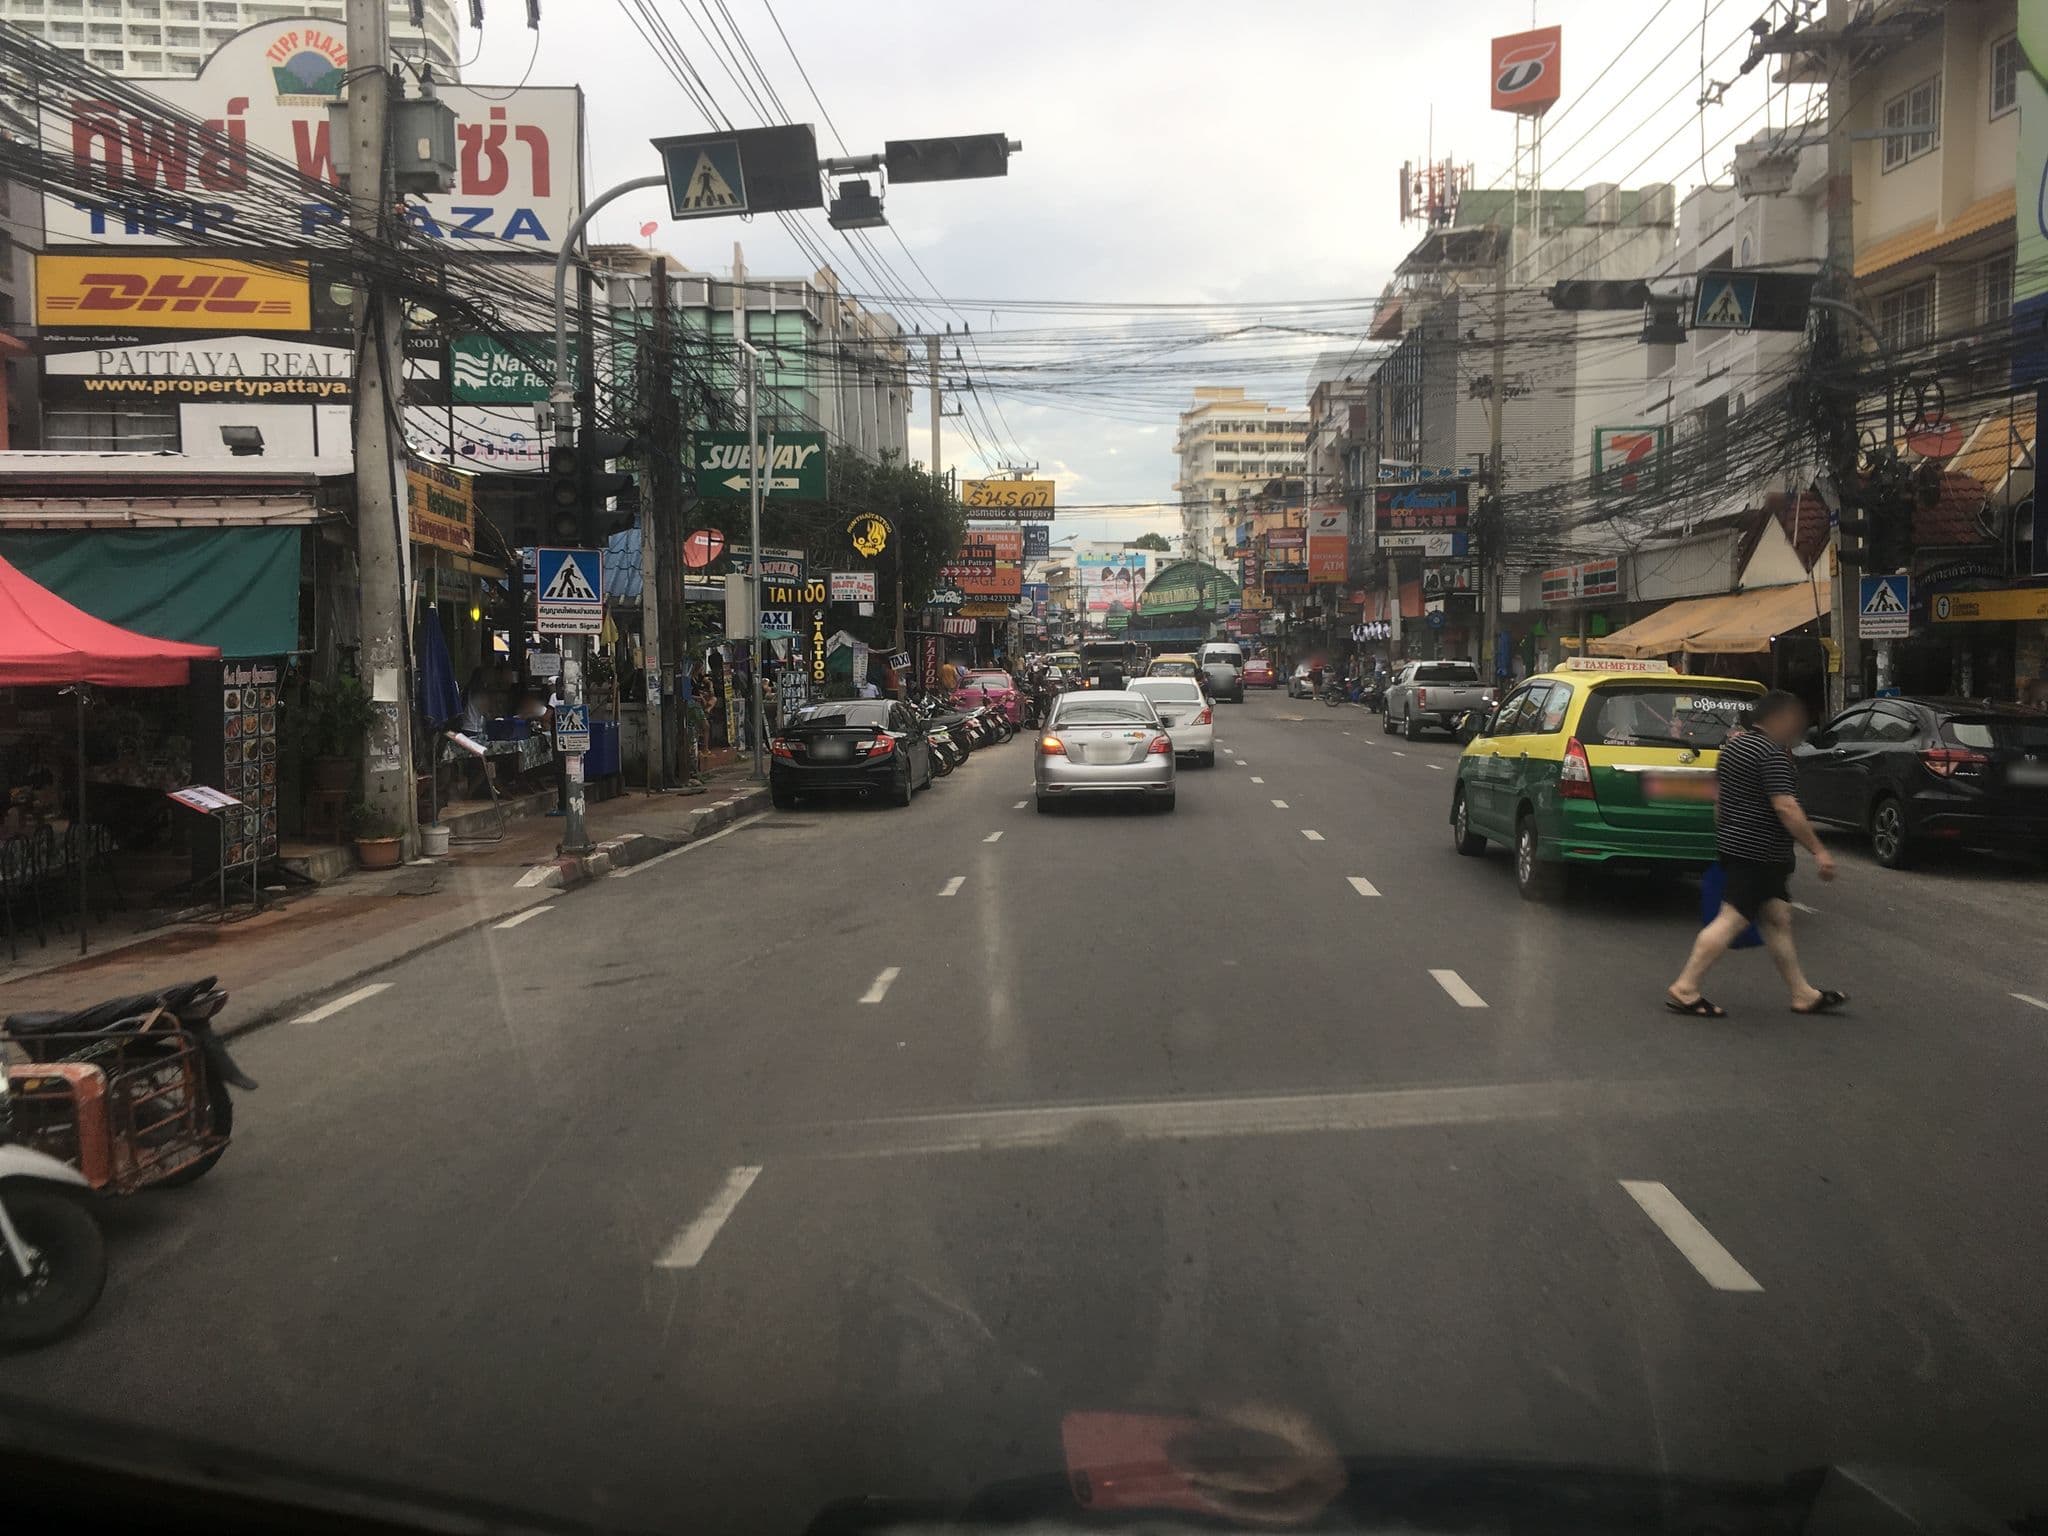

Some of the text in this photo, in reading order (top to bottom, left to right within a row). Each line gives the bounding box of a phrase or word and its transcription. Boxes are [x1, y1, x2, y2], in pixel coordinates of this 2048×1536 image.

[266, 30, 348, 67] TIPP PLAZA
[292, 106, 549, 200] พซ่า
[75, 202, 550, 242] TIPP PAZA
[77, 273, 264, 313] DHL
[95, 349, 247, 377] PATTAYA
[84, 378, 352, 396] www.propertypattaya.
[490, 372, 519, 388] Car
[701, 443, 821, 470] SUBWAY
[967, 509, 1051, 519] osmetic & surgery
[972, 548, 992, 558] Inn
[968, 559, 993, 567] Pattaya
[1323, 561, 1344, 571] ATM
[1001, 577, 1016, 586] 10
[579, 622, 600, 630] Signal
[761, 612, 788, 624] AXI
[943, 618, 977, 634] TATTOO
[813, 621, 825, 680] TATTOO
[890, 653, 909, 669] TAXI
[925, 640, 936, 684] TATTOO
[1584, 660, 1647, 671] TAXI-METER
